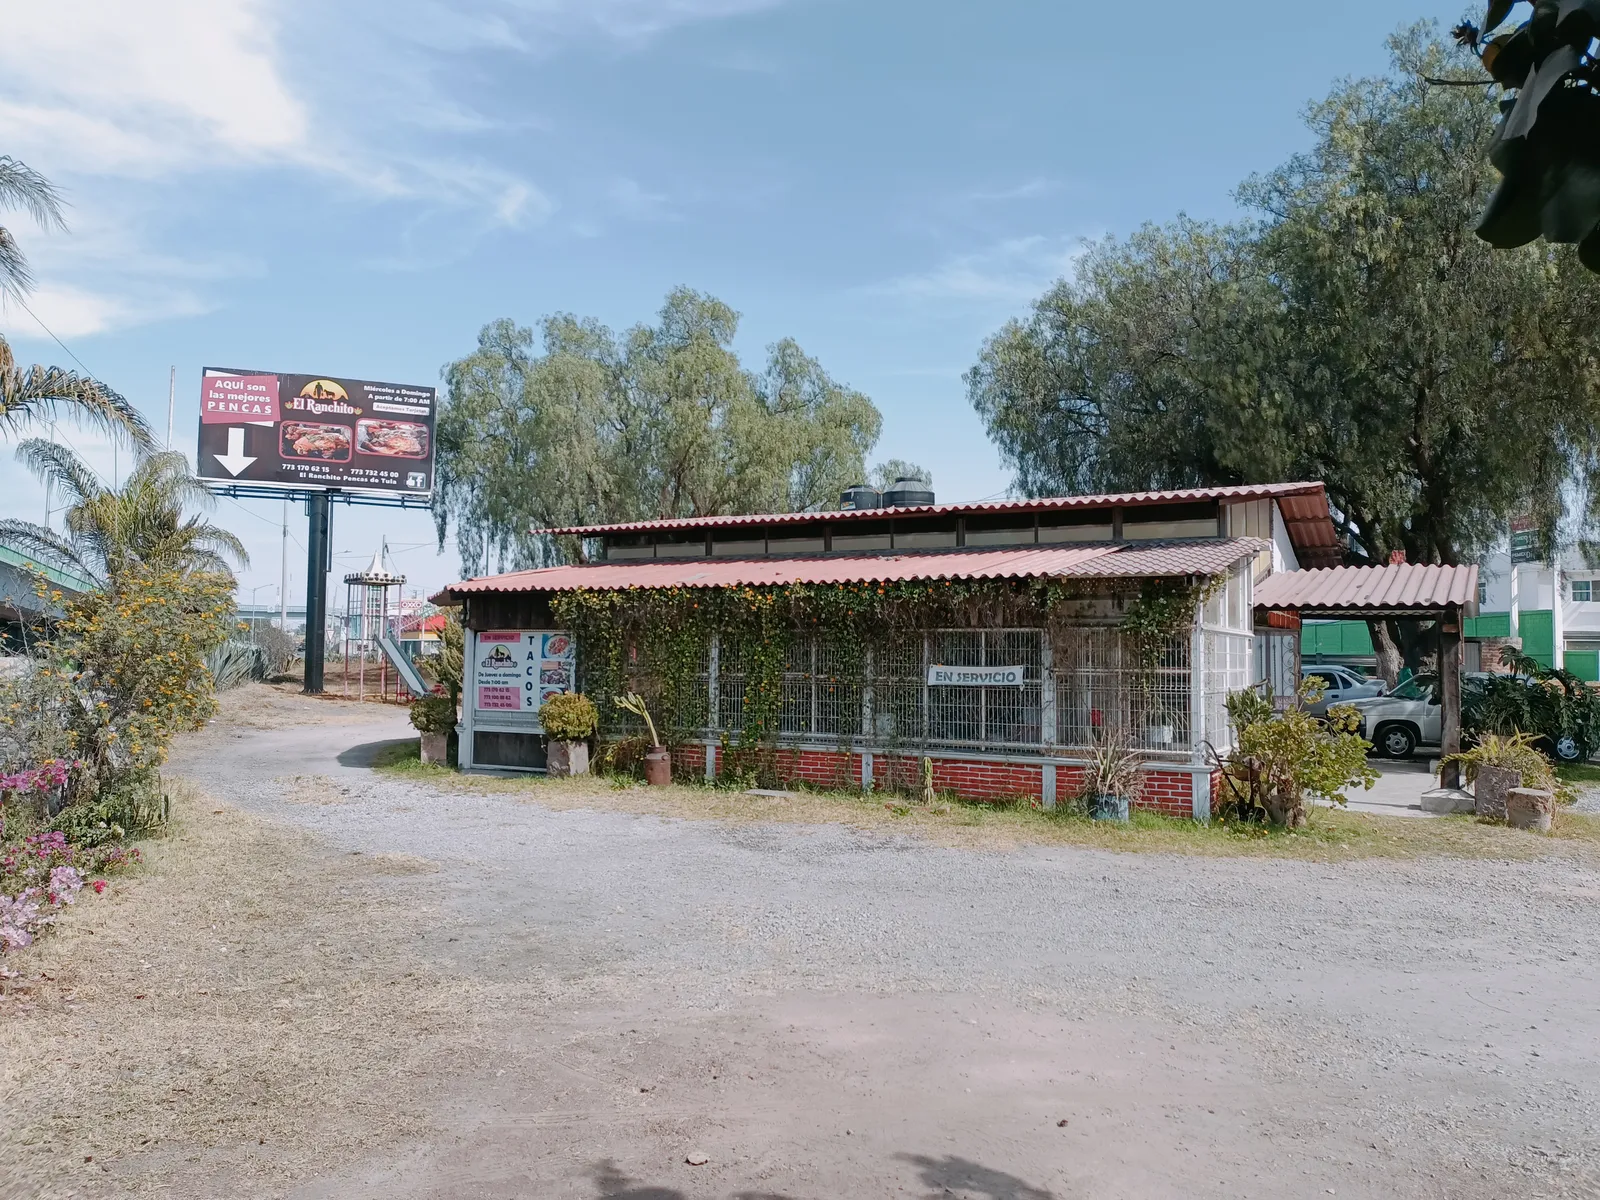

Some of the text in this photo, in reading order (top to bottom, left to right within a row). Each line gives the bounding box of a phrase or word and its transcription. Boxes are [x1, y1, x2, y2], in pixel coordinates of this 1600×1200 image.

[215, 380, 244, 390] AQUÍ
[364, 385, 394, 394] Miércoles
[402, 389, 430, 398] Domingo
[209, 390, 270, 403] las mejores
[375, 394, 392, 402] partir
[207, 401, 272, 414] PENCAS
[293, 397, 354, 415] El Ranchito
[308, 472, 341, 481] Ranchito
[343, 475, 368, 483] Pencas
[525, 636, 535, 706] TACOS
[935, 671, 1017, 683] EN SERVICIO
